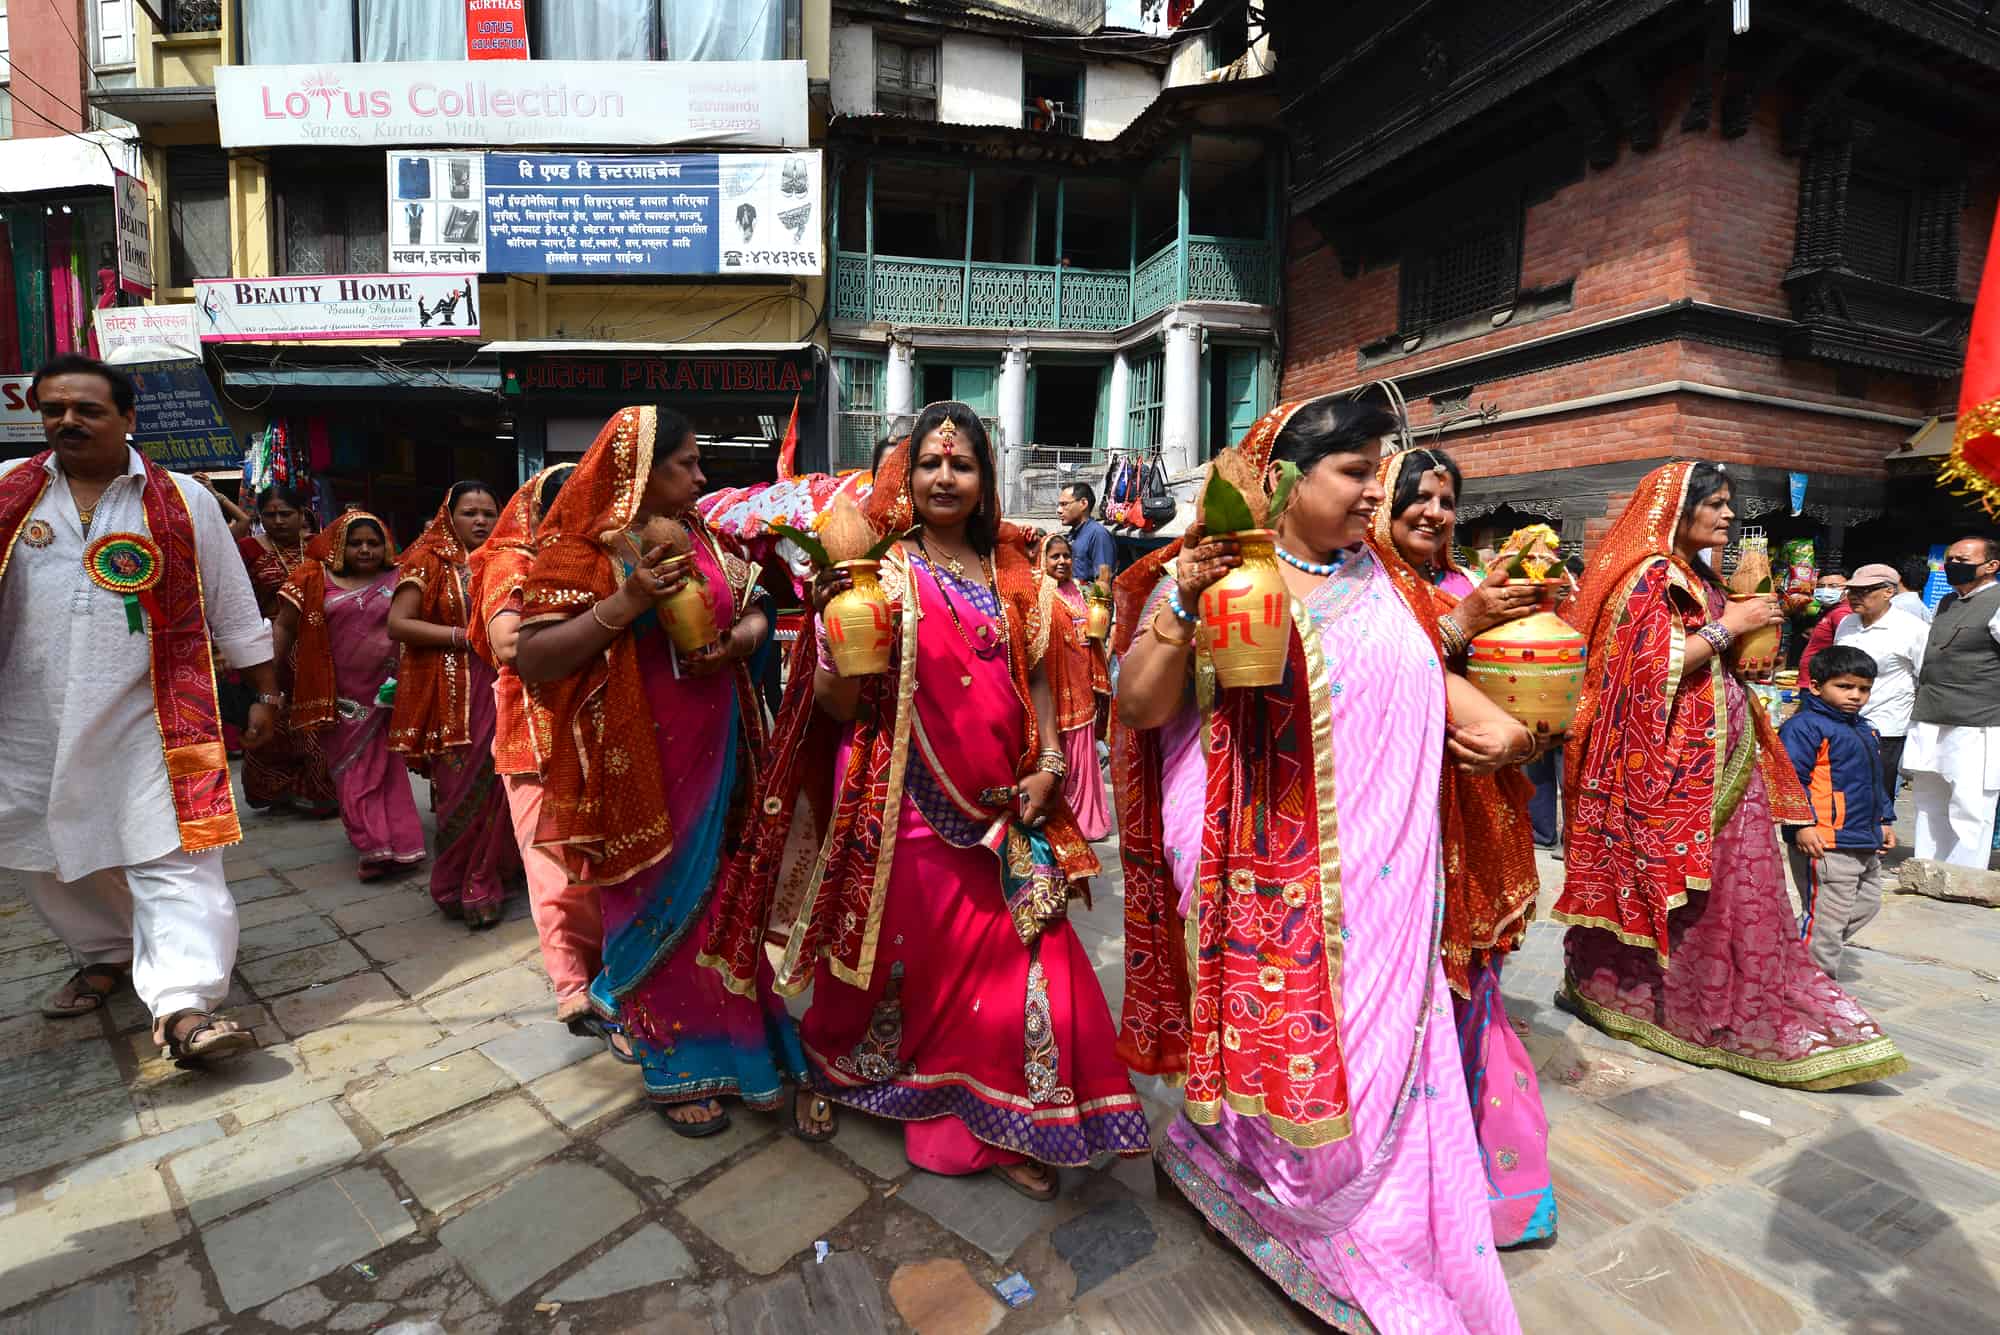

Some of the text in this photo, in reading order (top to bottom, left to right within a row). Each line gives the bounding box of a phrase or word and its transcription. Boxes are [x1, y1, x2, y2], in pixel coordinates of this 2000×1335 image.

[478, 20, 513, 33] LOTUS
[471, 38, 524, 49] COLLECTION
[408, 80, 624, 117] Collection
[375, 122, 433, 138] Kurtas
[429, 247, 481, 266] इन्द्रचोक
[323, 301, 414, 316] Beauty Parlour
[622, 359, 801, 391] PRATIBHA
